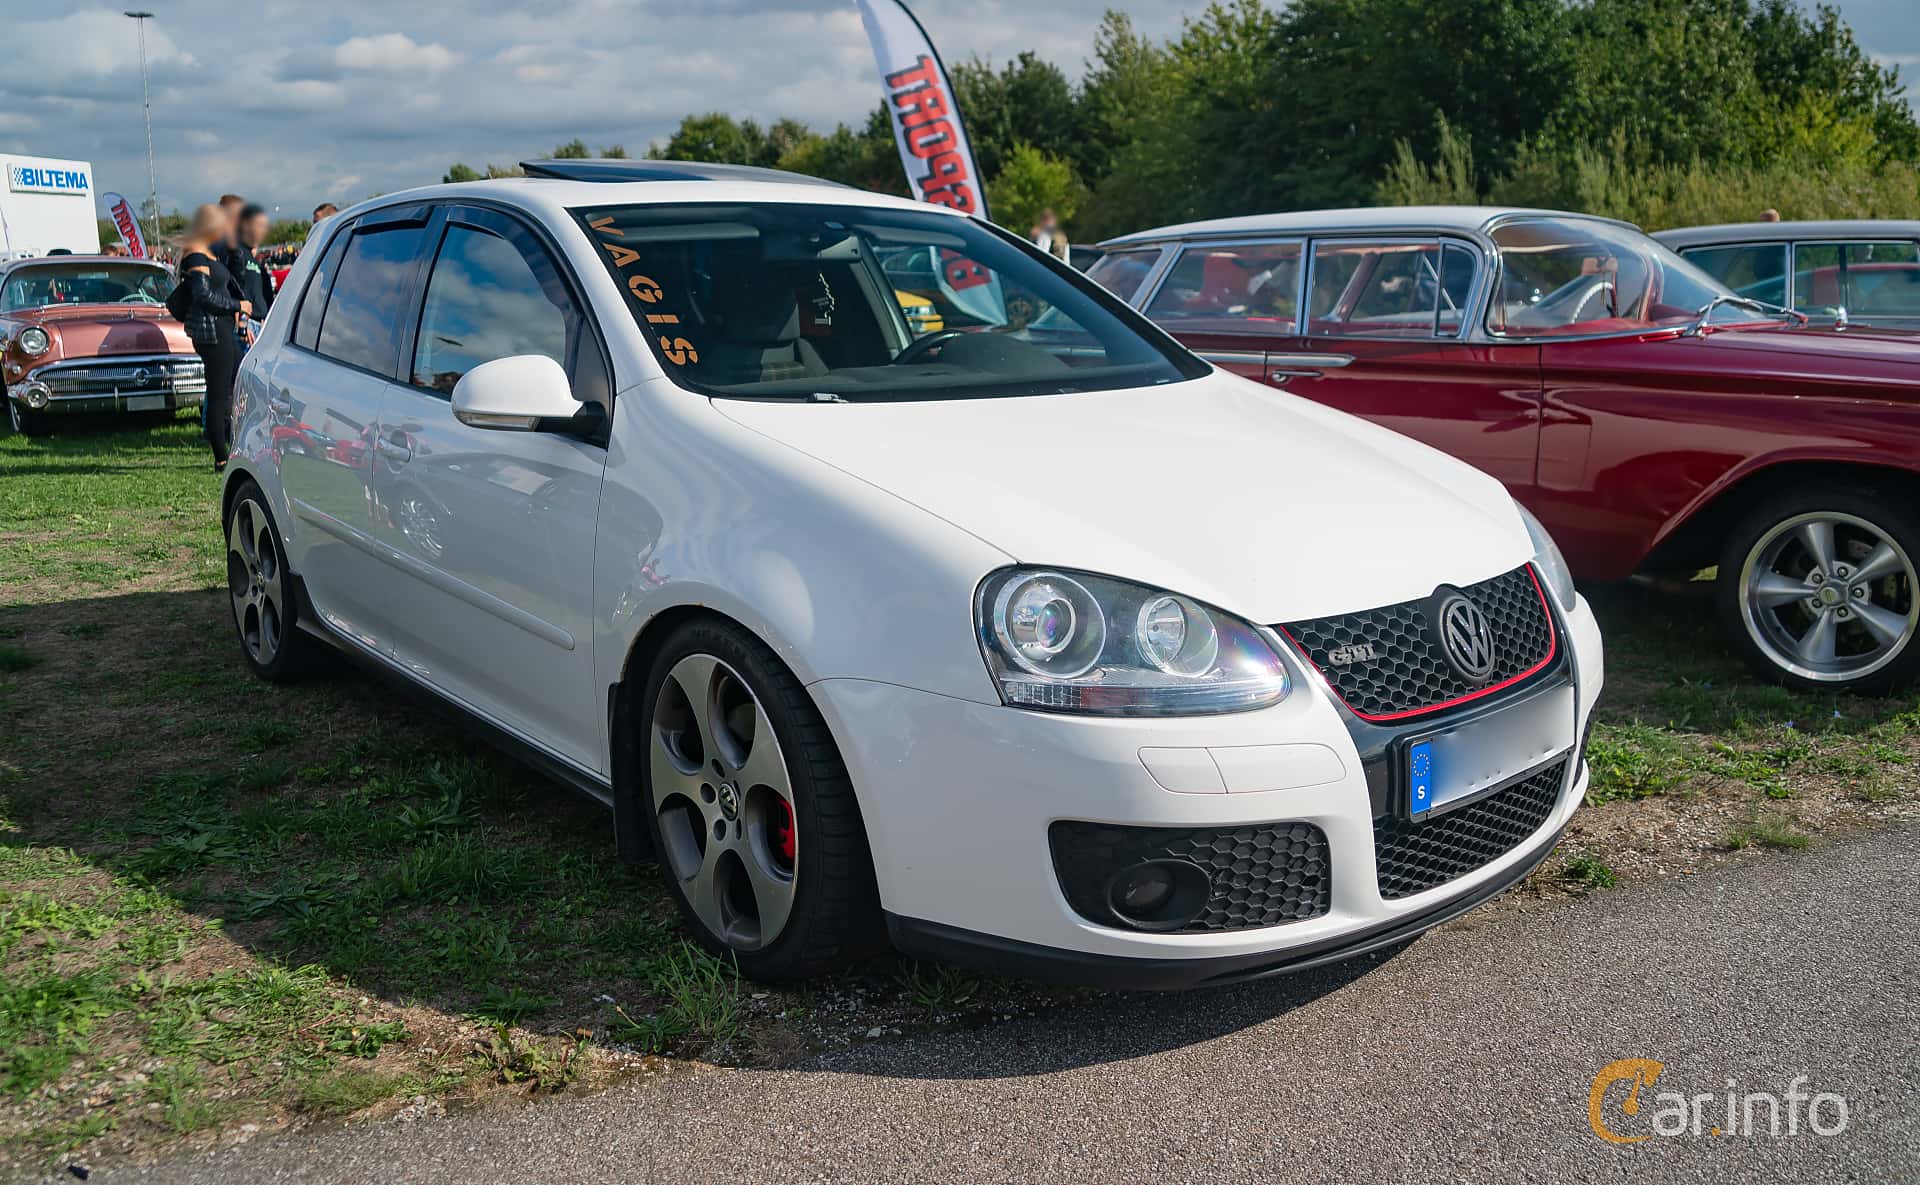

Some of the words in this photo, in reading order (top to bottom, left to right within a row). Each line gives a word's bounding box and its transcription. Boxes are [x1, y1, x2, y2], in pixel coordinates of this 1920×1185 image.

[22, 167, 88, 189] BILTEMA
[590, 216, 699, 366] VAGIS
[1447, 601, 1494, 674] VW
[1328, 643, 1376, 666] GTI
[1417, 785, 1426, 800] S
